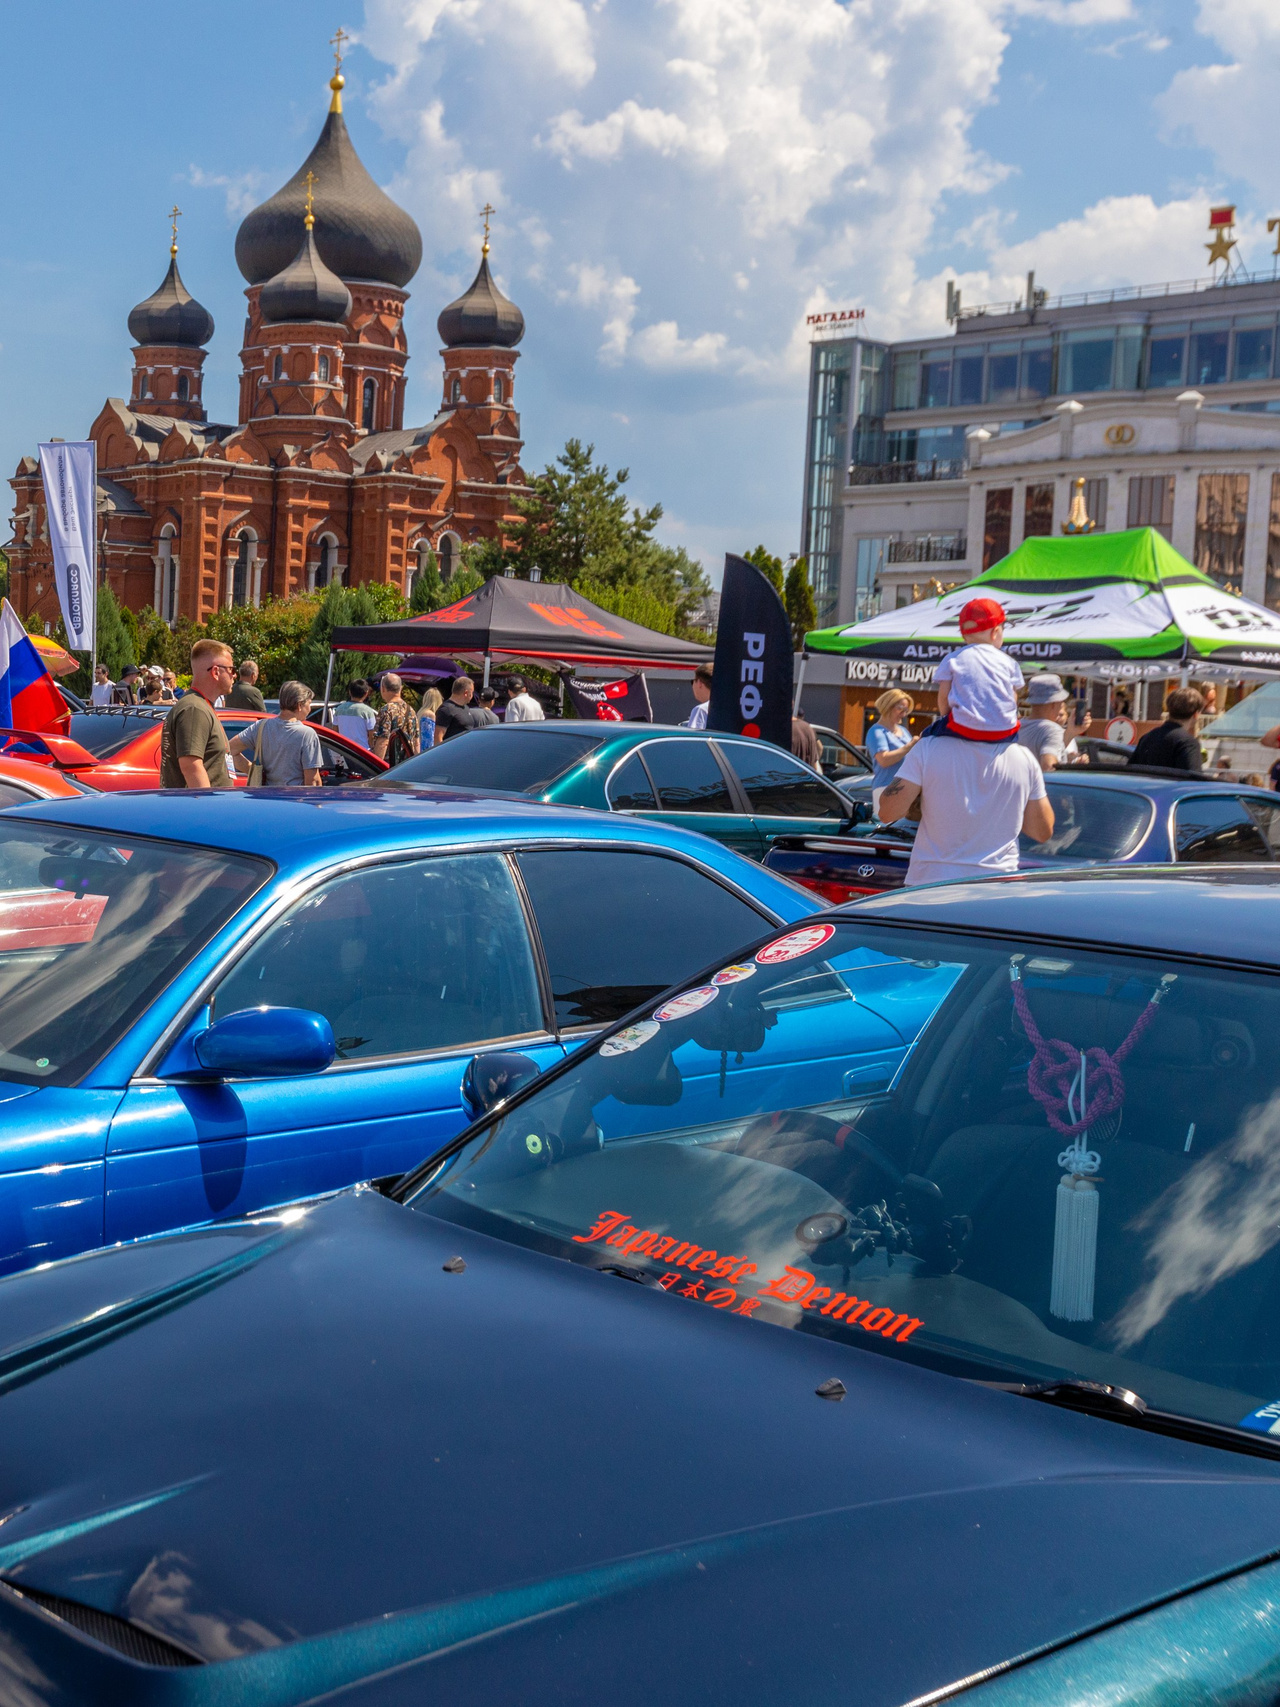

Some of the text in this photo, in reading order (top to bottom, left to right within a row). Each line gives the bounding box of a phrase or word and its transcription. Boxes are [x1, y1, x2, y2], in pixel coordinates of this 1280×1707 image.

[807, 309, 865, 324] МАГАДАН
[903, 643, 1062, 658] ALPH ROUP
[740, 632, 766, 720] РЕФ
[847, 660, 887, 681] КОФЕ
[572, 1210, 925, 1343] Japanese Demon
[658, 1271, 762, 1317] 日本の鬼
